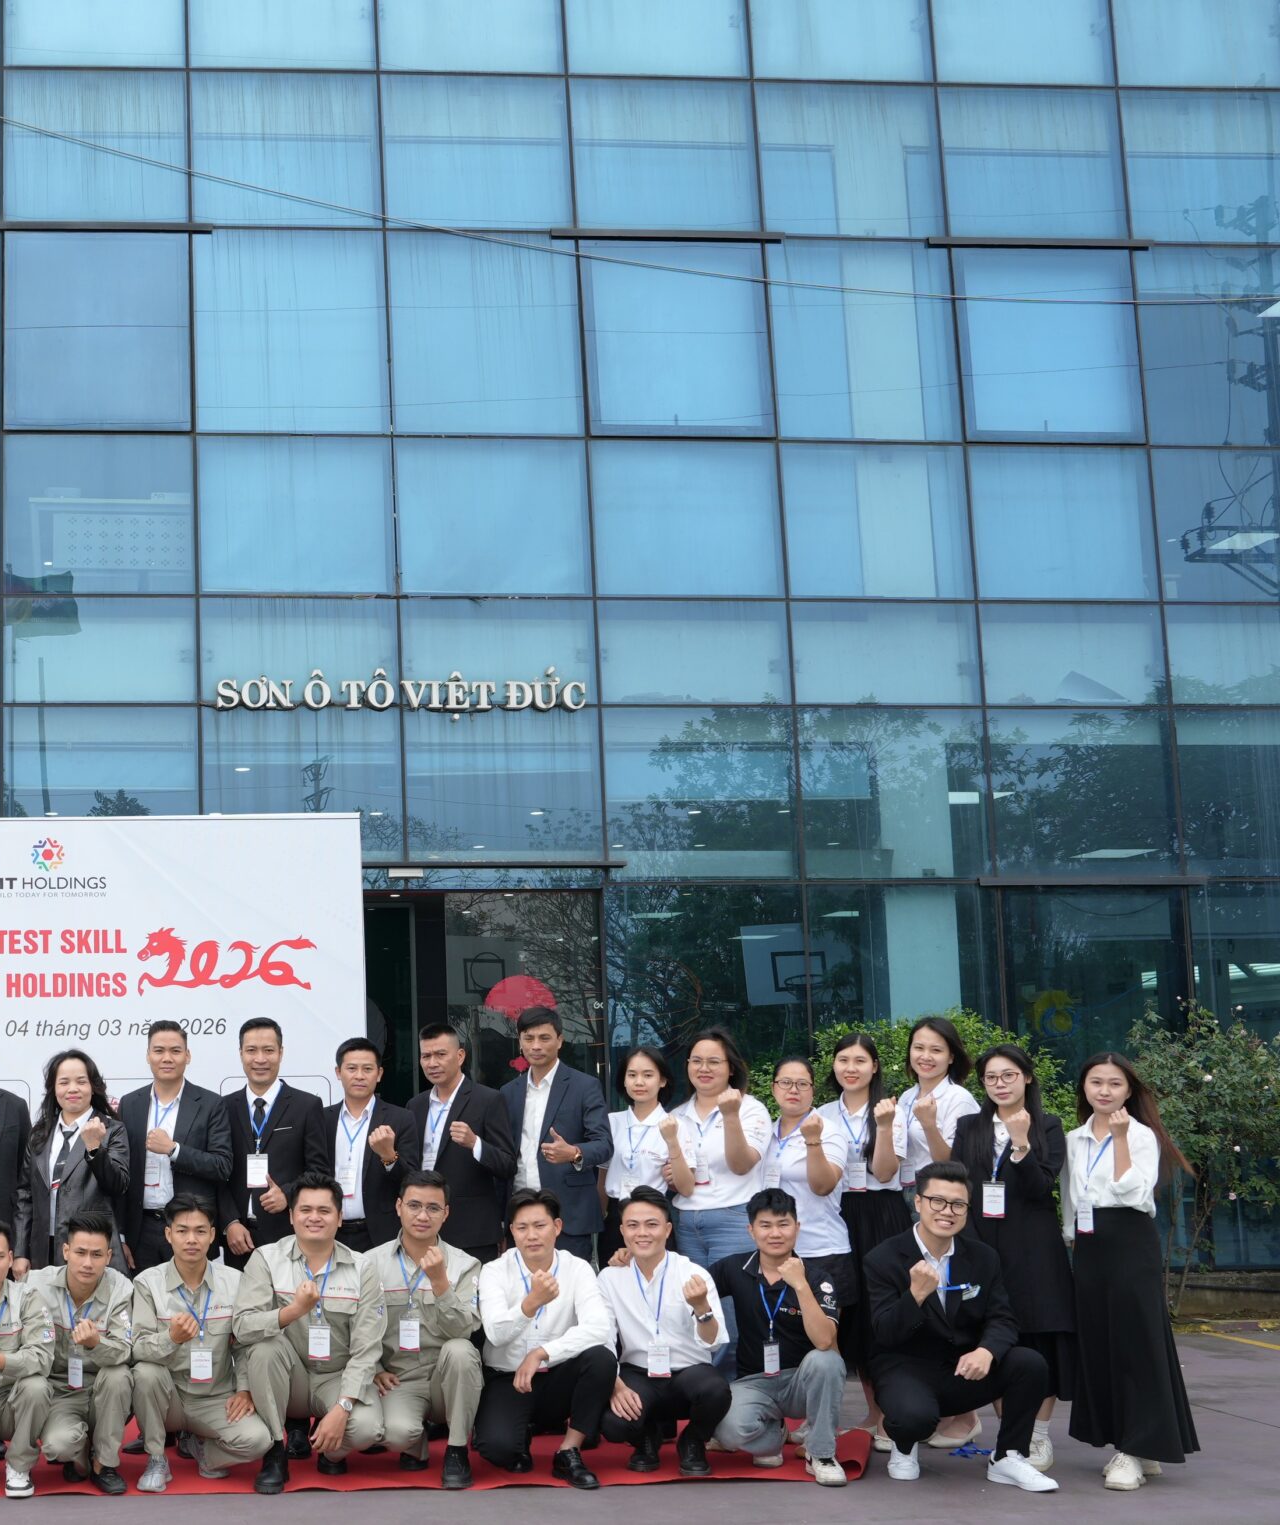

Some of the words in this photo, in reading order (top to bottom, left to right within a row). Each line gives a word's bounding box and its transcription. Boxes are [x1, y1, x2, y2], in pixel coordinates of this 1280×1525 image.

[216, 675, 293, 709] SƠN
[304, 668, 331, 709] Ô
[341, 667, 395, 709] TÔ
[400, 670, 496, 722] VIỆT
[504, 666, 587, 710] ĐỨC
[22, 876, 107, 890] HOLDINGS
[15, 891, 40, 899] TODAY
[43, 891, 58, 899] FOR
[61, 891, 107, 899] TOMORROW
[60, 929, 127, 954] SKILL
[6, 972, 127, 998] HOLDINGS
[5, 1020, 29, 1036] 04
[35, 1018, 91, 1040] tháng
[97, 1018, 122, 1036] 03
[179, 1018, 227, 1036] 2026
